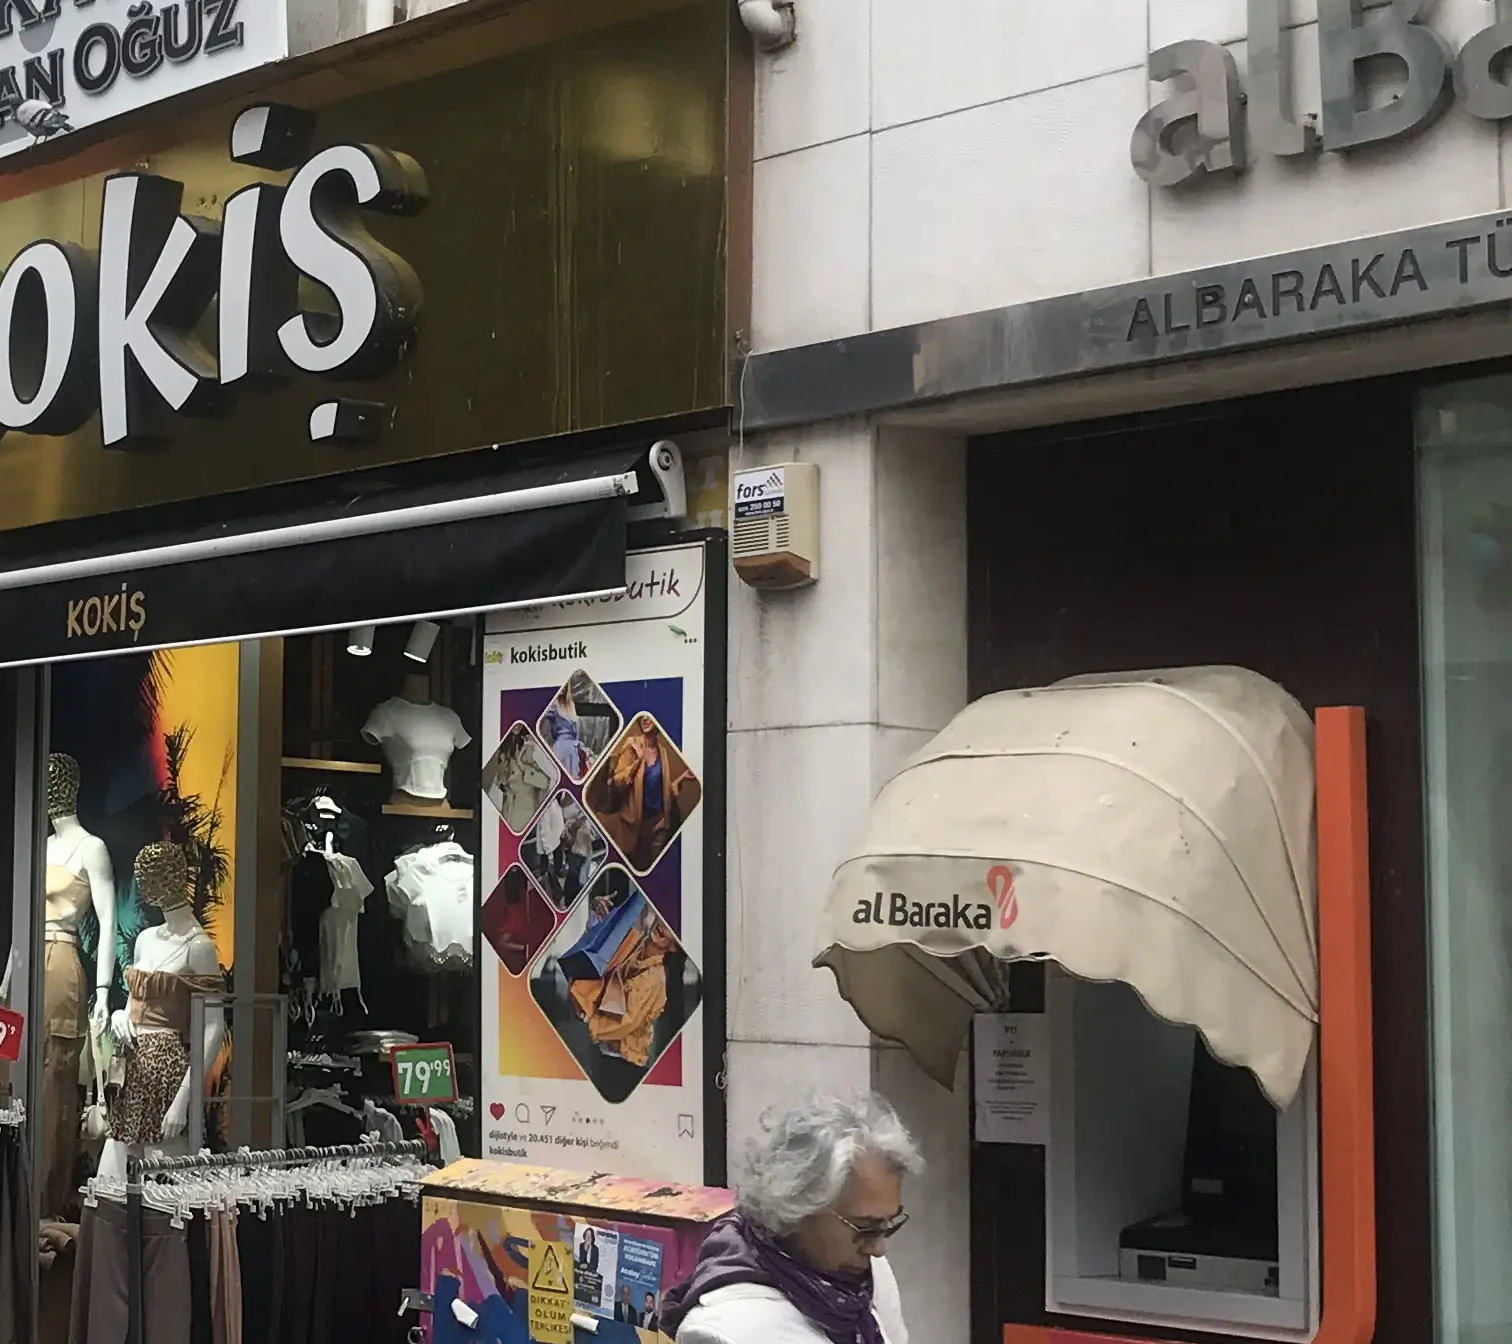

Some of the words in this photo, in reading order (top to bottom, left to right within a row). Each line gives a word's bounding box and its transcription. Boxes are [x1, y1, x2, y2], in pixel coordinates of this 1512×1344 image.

[1126, 248, 1429, 343] ALBARAKA
[737, 484, 766, 499] fors
[66, 583, 146, 642] KOKİŞ
[510, 642, 588, 664] kokisbutik
[528, 1133, 553, 1145] 20.451
[554, 1136, 574, 1147] diğer
